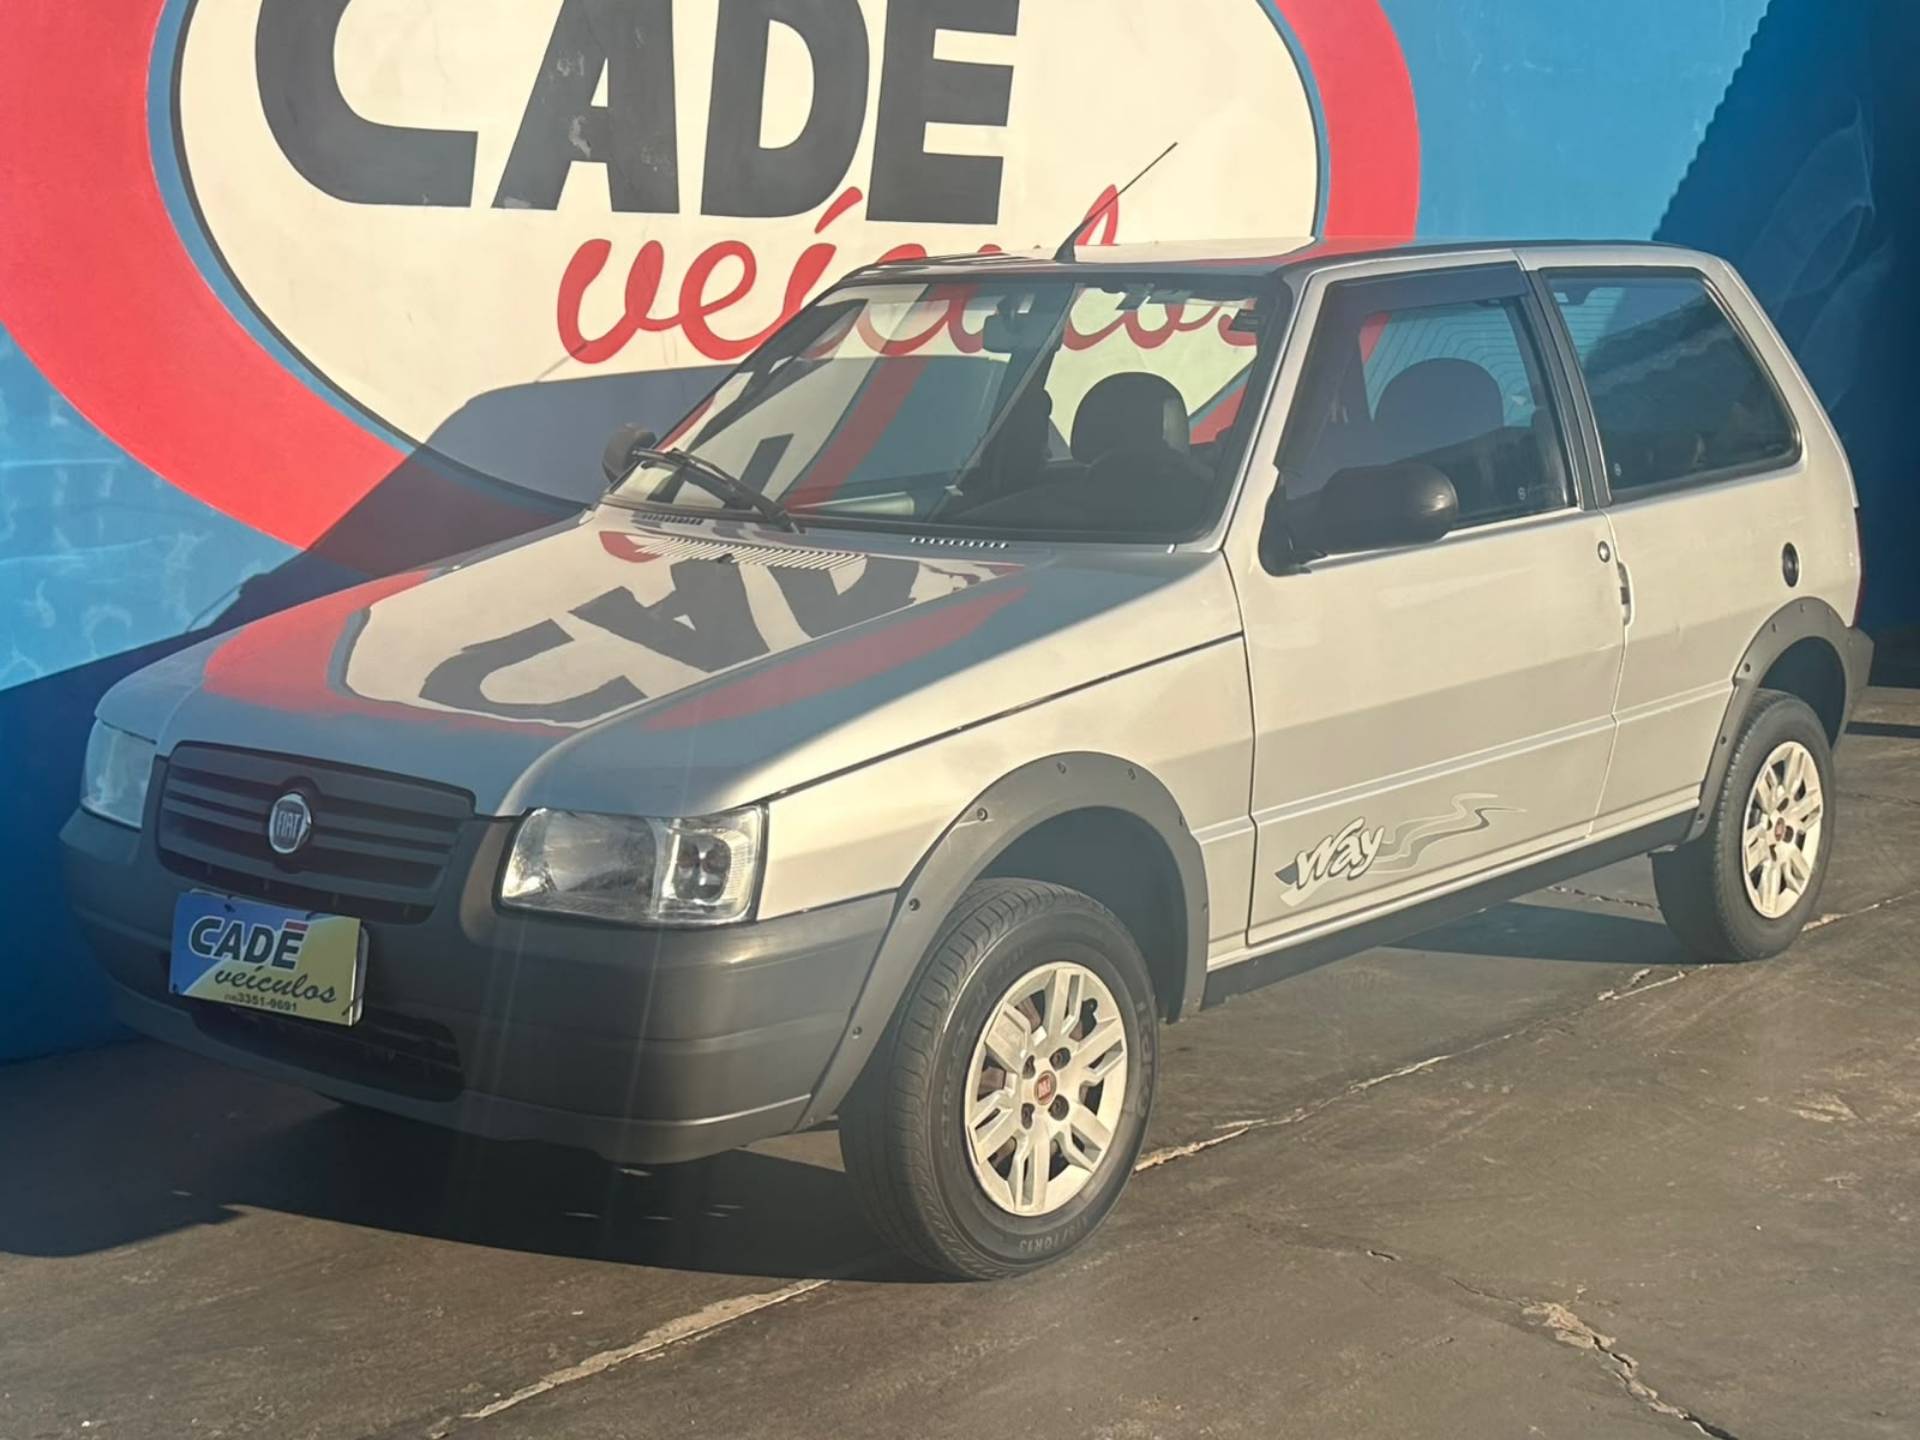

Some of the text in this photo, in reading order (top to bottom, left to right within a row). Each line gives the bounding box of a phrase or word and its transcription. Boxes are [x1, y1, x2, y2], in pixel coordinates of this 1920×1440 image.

[275, 809, 302, 841] FIAT
[1294, 816, 1385, 890] Way
[214, 965, 336, 1003] veículos
